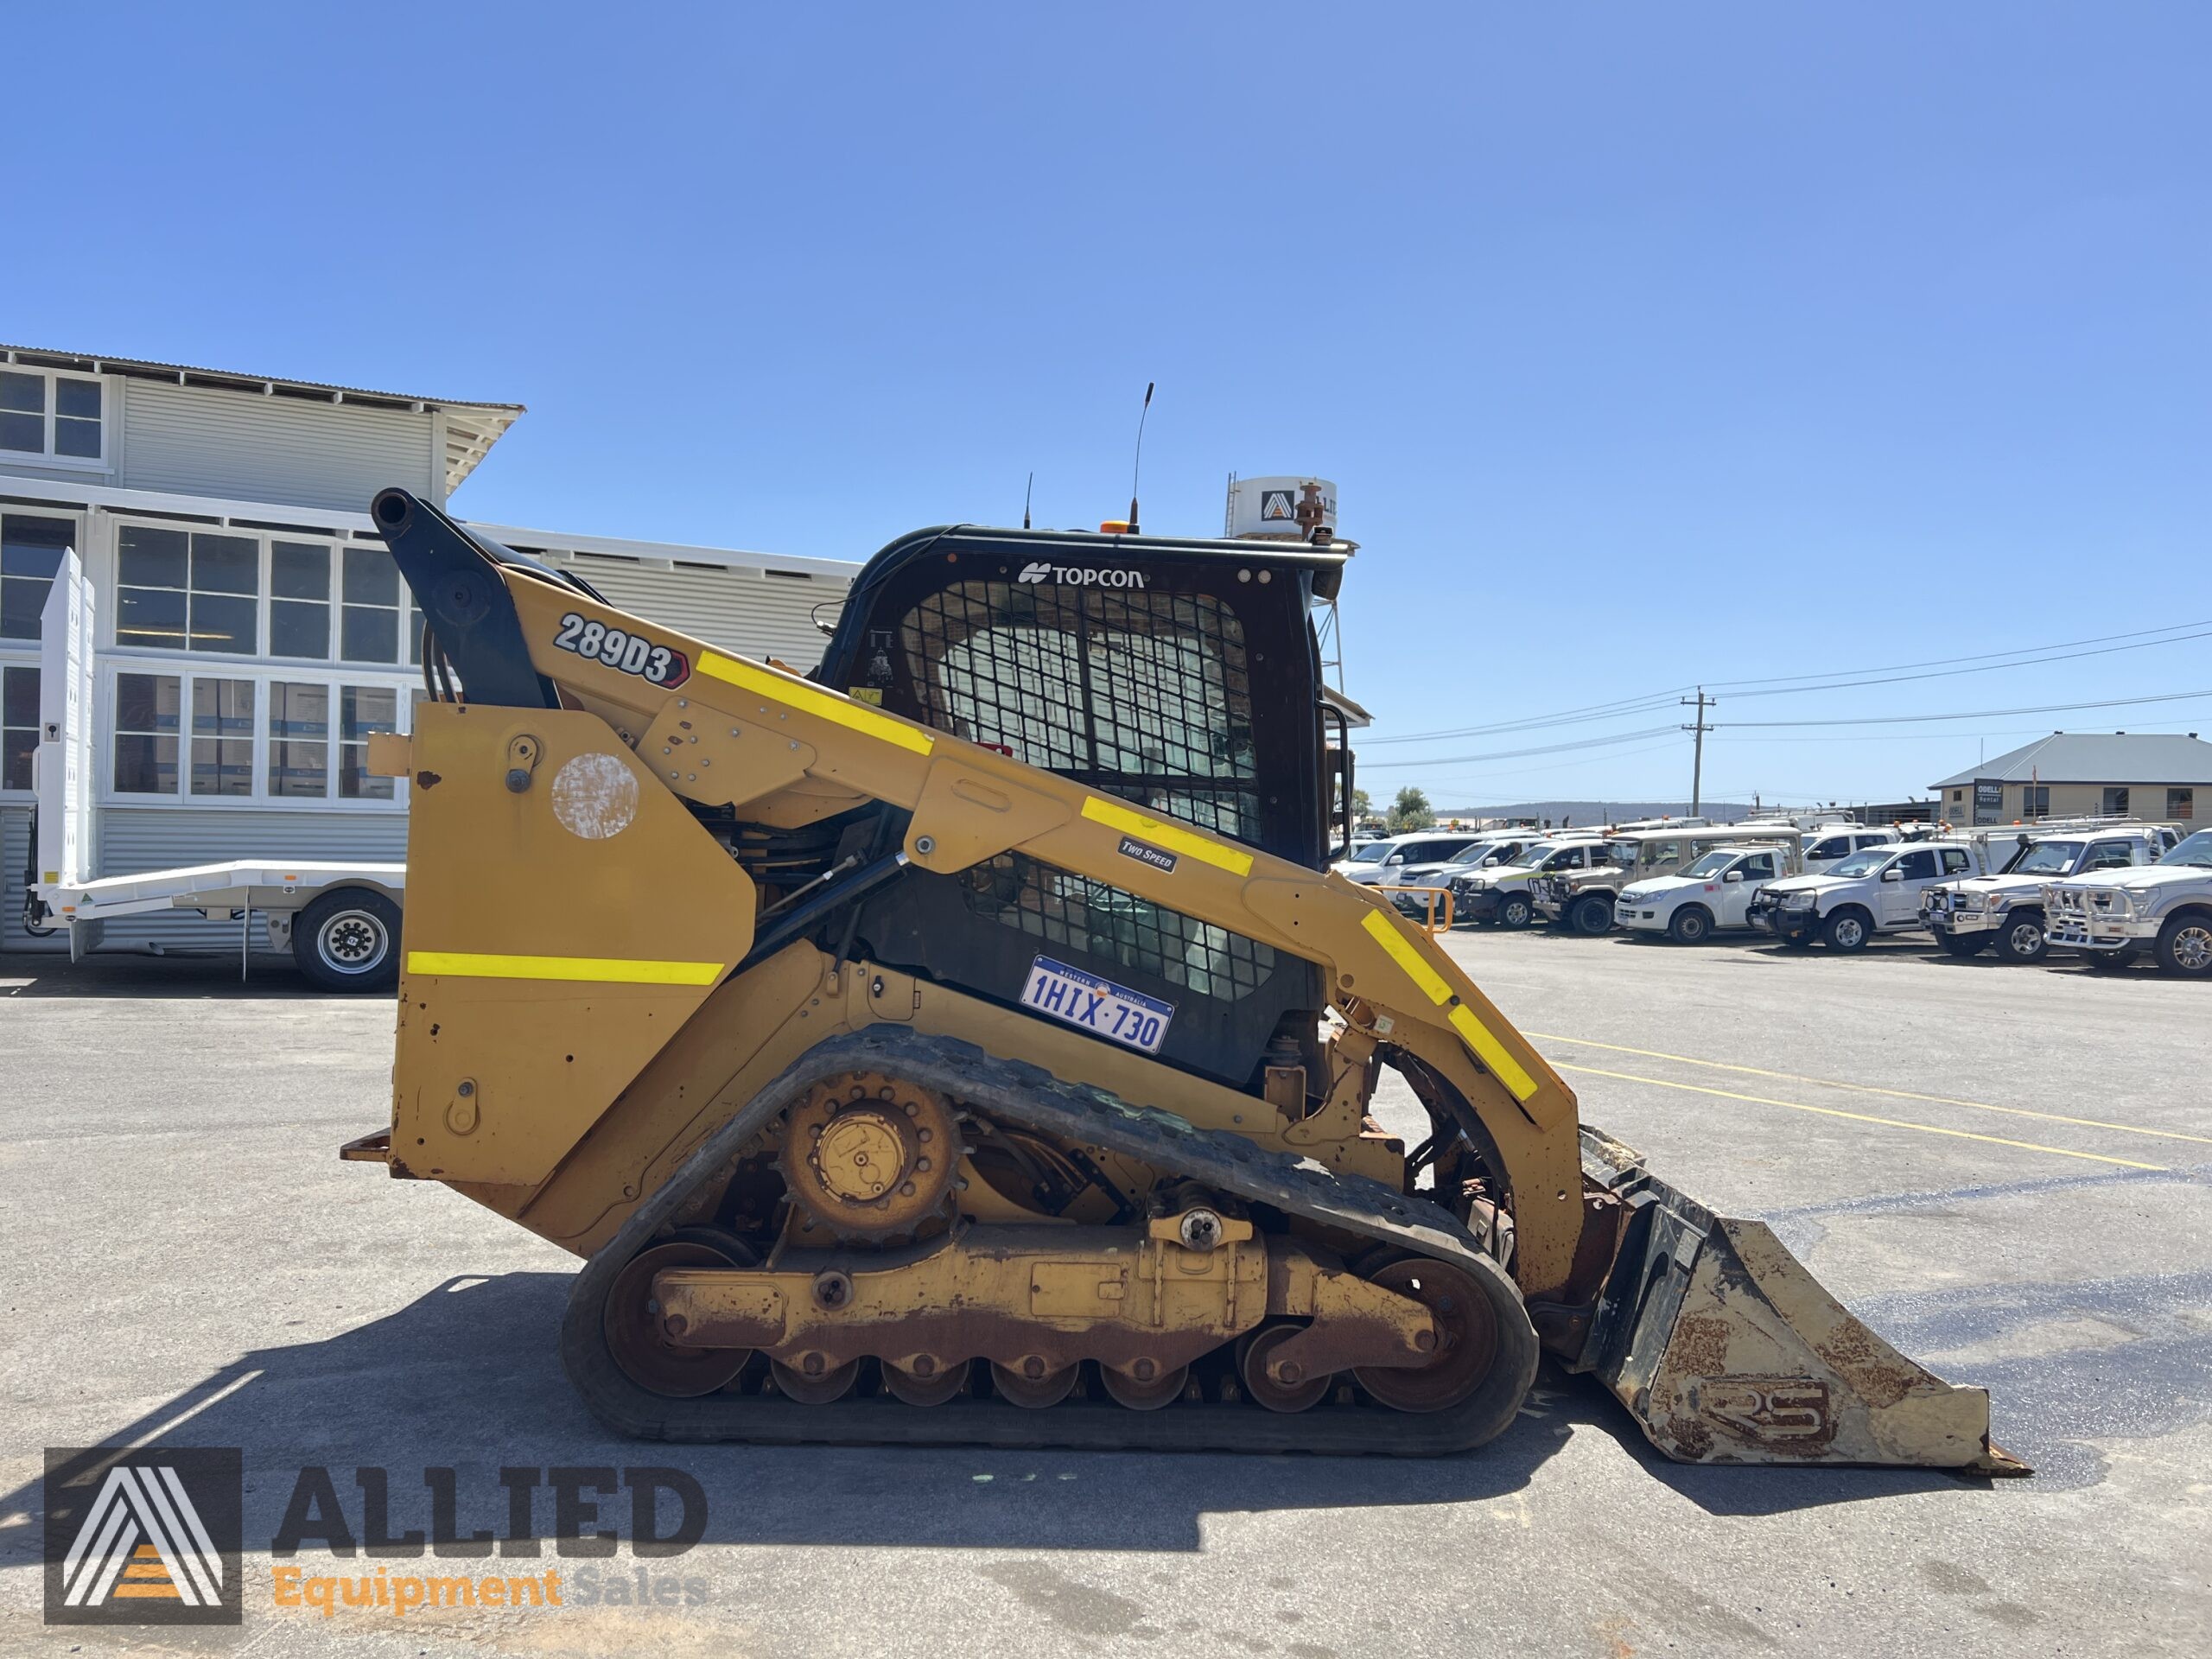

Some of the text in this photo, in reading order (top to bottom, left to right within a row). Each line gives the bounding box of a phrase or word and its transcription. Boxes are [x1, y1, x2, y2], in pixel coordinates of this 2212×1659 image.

[1052, 567, 1145, 588] TOPCON
[556, 613, 672, 683] 289D3
[1143, 849, 1173, 868] SPEED
[1059, 969, 1147, 1008] WESTERN AUSTRALIA
